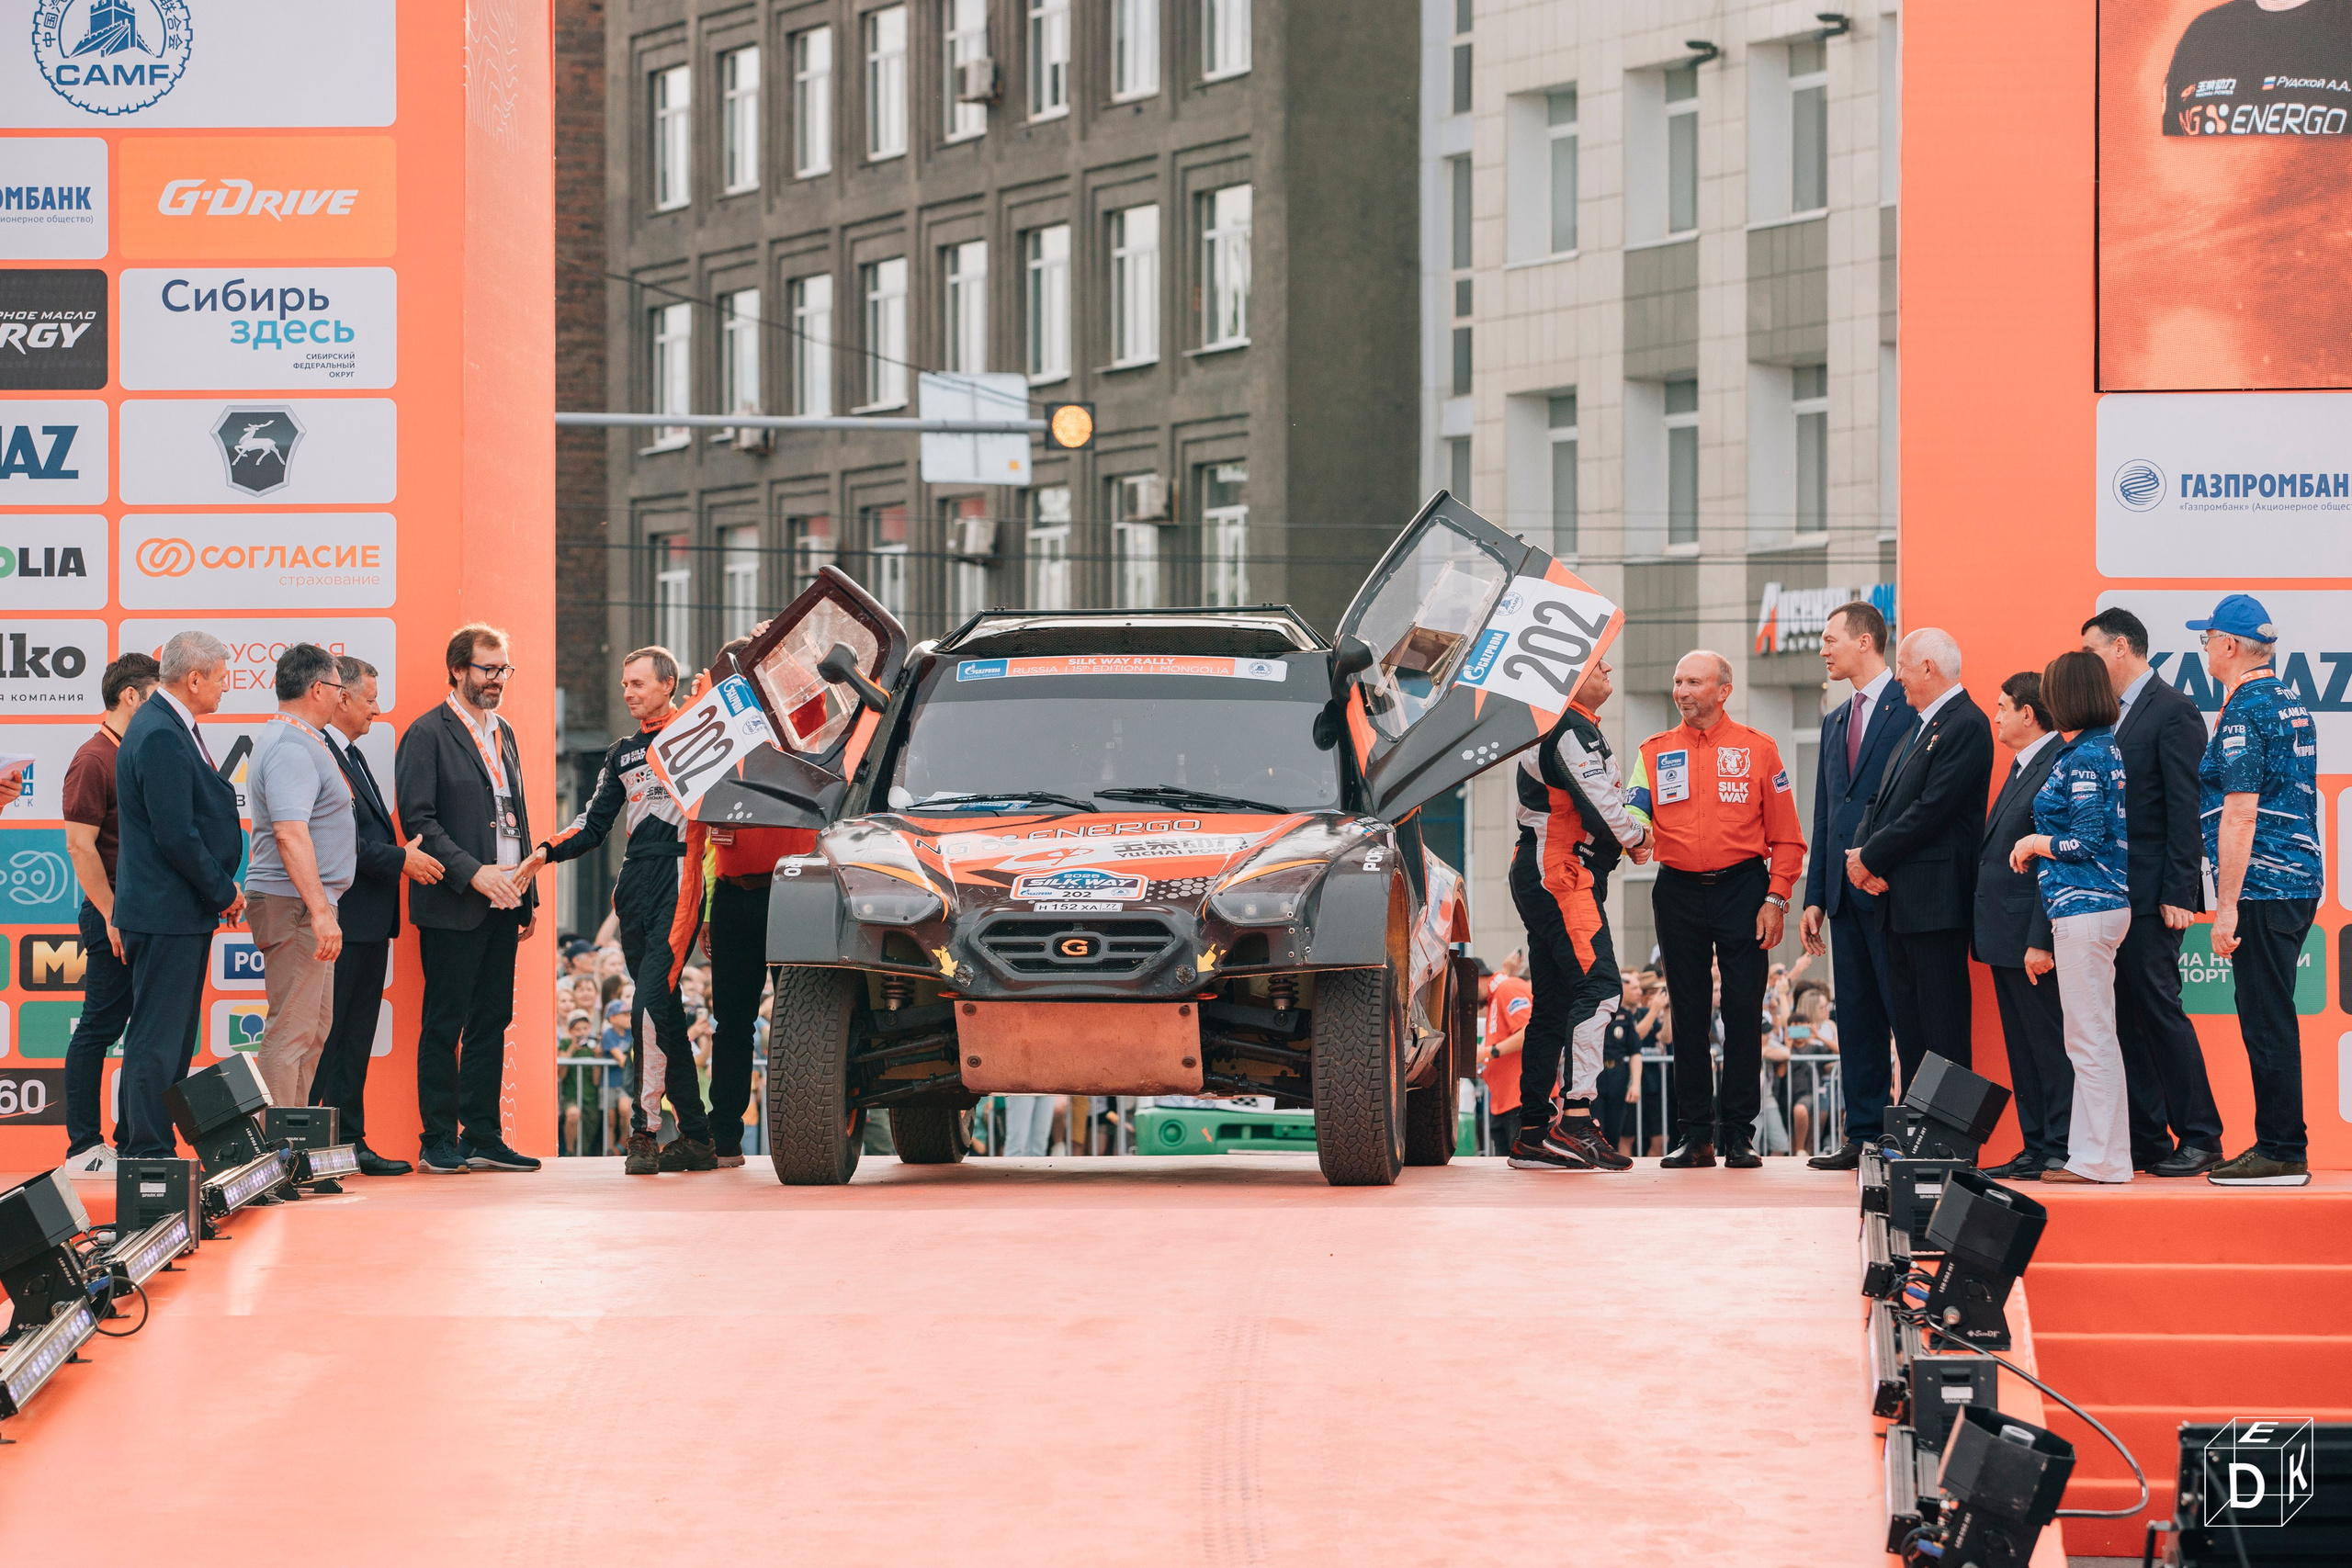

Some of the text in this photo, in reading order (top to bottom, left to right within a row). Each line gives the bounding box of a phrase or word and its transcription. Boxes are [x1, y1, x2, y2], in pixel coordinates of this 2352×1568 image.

[56, 64, 169, 85] CAMF
[2231, 103, 2347, 135] ENERGO
[47, 214, 94, 224] общество)
[162, 278, 330, 321] Сибирь
[230, 319, 356, 351] здесь
[306, 351, 356, 360] СИБИРСКИЙ
[293, 360, 356, 370] ФЕДЕРАЛЬНЫЙ
[0, 425, 79, 479] AZ
[2181, 473, 2352, 499] ГАЗПРОМБАН
[2179, 502, 2249, 513] «Газпромбанк»
[2252, 502, 2318, 513] (Акционерное
[200, 545, 380, 570] СОГЛАСИЕ
[278, 575, 380, 588] страхование
[1476, 632, 1505, 669] GAZPROM
[1502, 600, 1611, 697] 202
[1012, 665, 1058, 675] RUSSIA
[1071, 664, 1091, 673] 15th
[1160, 664, 1229, 675] MONGOLIA
[2147, 651, 2352, 712] KAAZ
[11, 694, 84, 702] КОМПАНИЯ
[2228, 725, 2246, 734] VTB
[658, 705, 734, 797] 202
[2079, 771, 2097, 780] VTB
[1718, 781, 1749, 793] SILK
[1719, 793, 1748, 804] WAY
[1028, 818, 1202, 844] ENERGO
[1117, 850, 1184, 858] YUCHAI
[1028, 878, 1134, 886] SILK WAY
[1061, 939, 1089, 956] G
